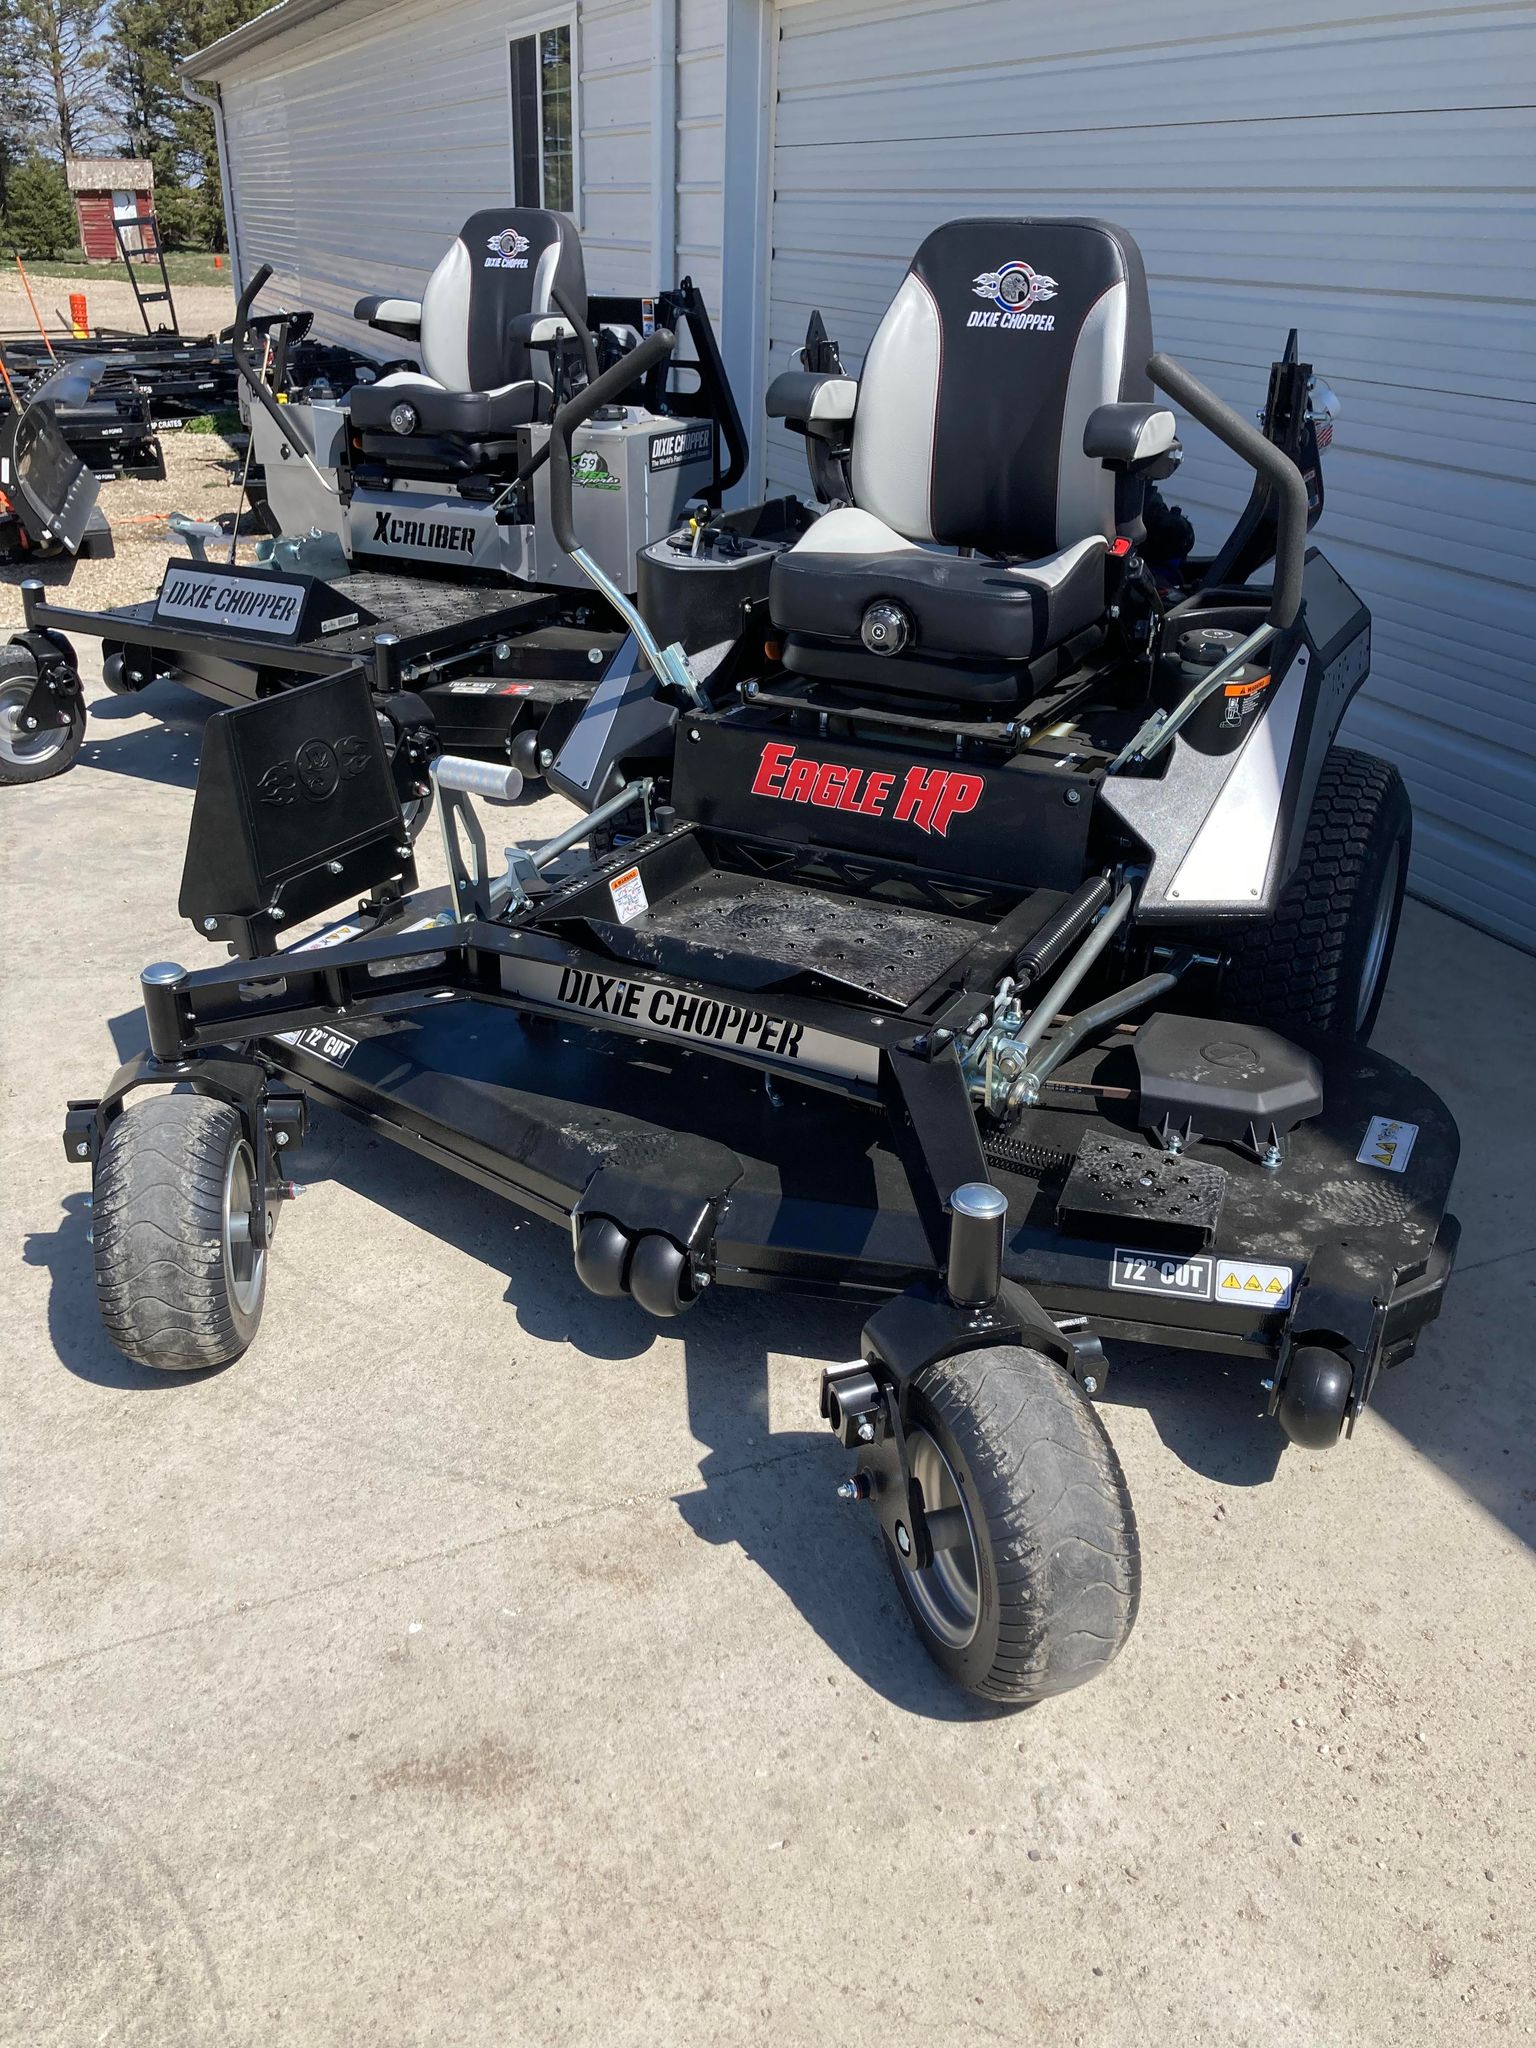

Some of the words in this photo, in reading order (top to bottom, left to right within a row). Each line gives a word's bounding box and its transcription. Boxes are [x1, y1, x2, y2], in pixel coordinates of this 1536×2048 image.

[484, 257, 502, 267] DIXIE
[501, 258, 529, 269] CHOPPER
[966, 311, 1001, 327] DIXIE
[1000, 312, 1054, 331] CHOPPER
[109, 427, 123, 435] FORKS
[158, 420, 183, 429] CRATES
[652, 436, 676, 459] DIXIE
[674, 429, 710, 454] CHOPPER
[580, 458, 596, 469] 59
[373, 511, 476, 557] XCALIBER
[166, 581, 217, 610] DIXIE
[214, 588, 298, 622] CHOPPER
[751, 742, 896, 816] EAGLE
[893, 766, 984, 837] HP
[557, 967, 645, 1019] DIXIE
[648, 989, 805, 1058] CHOPPER
[323, 1036, 351, 1060] CUT
[1123, 1257, 1157, 1281] 72"
[1160, 1261, 1203, 1288] CUT
